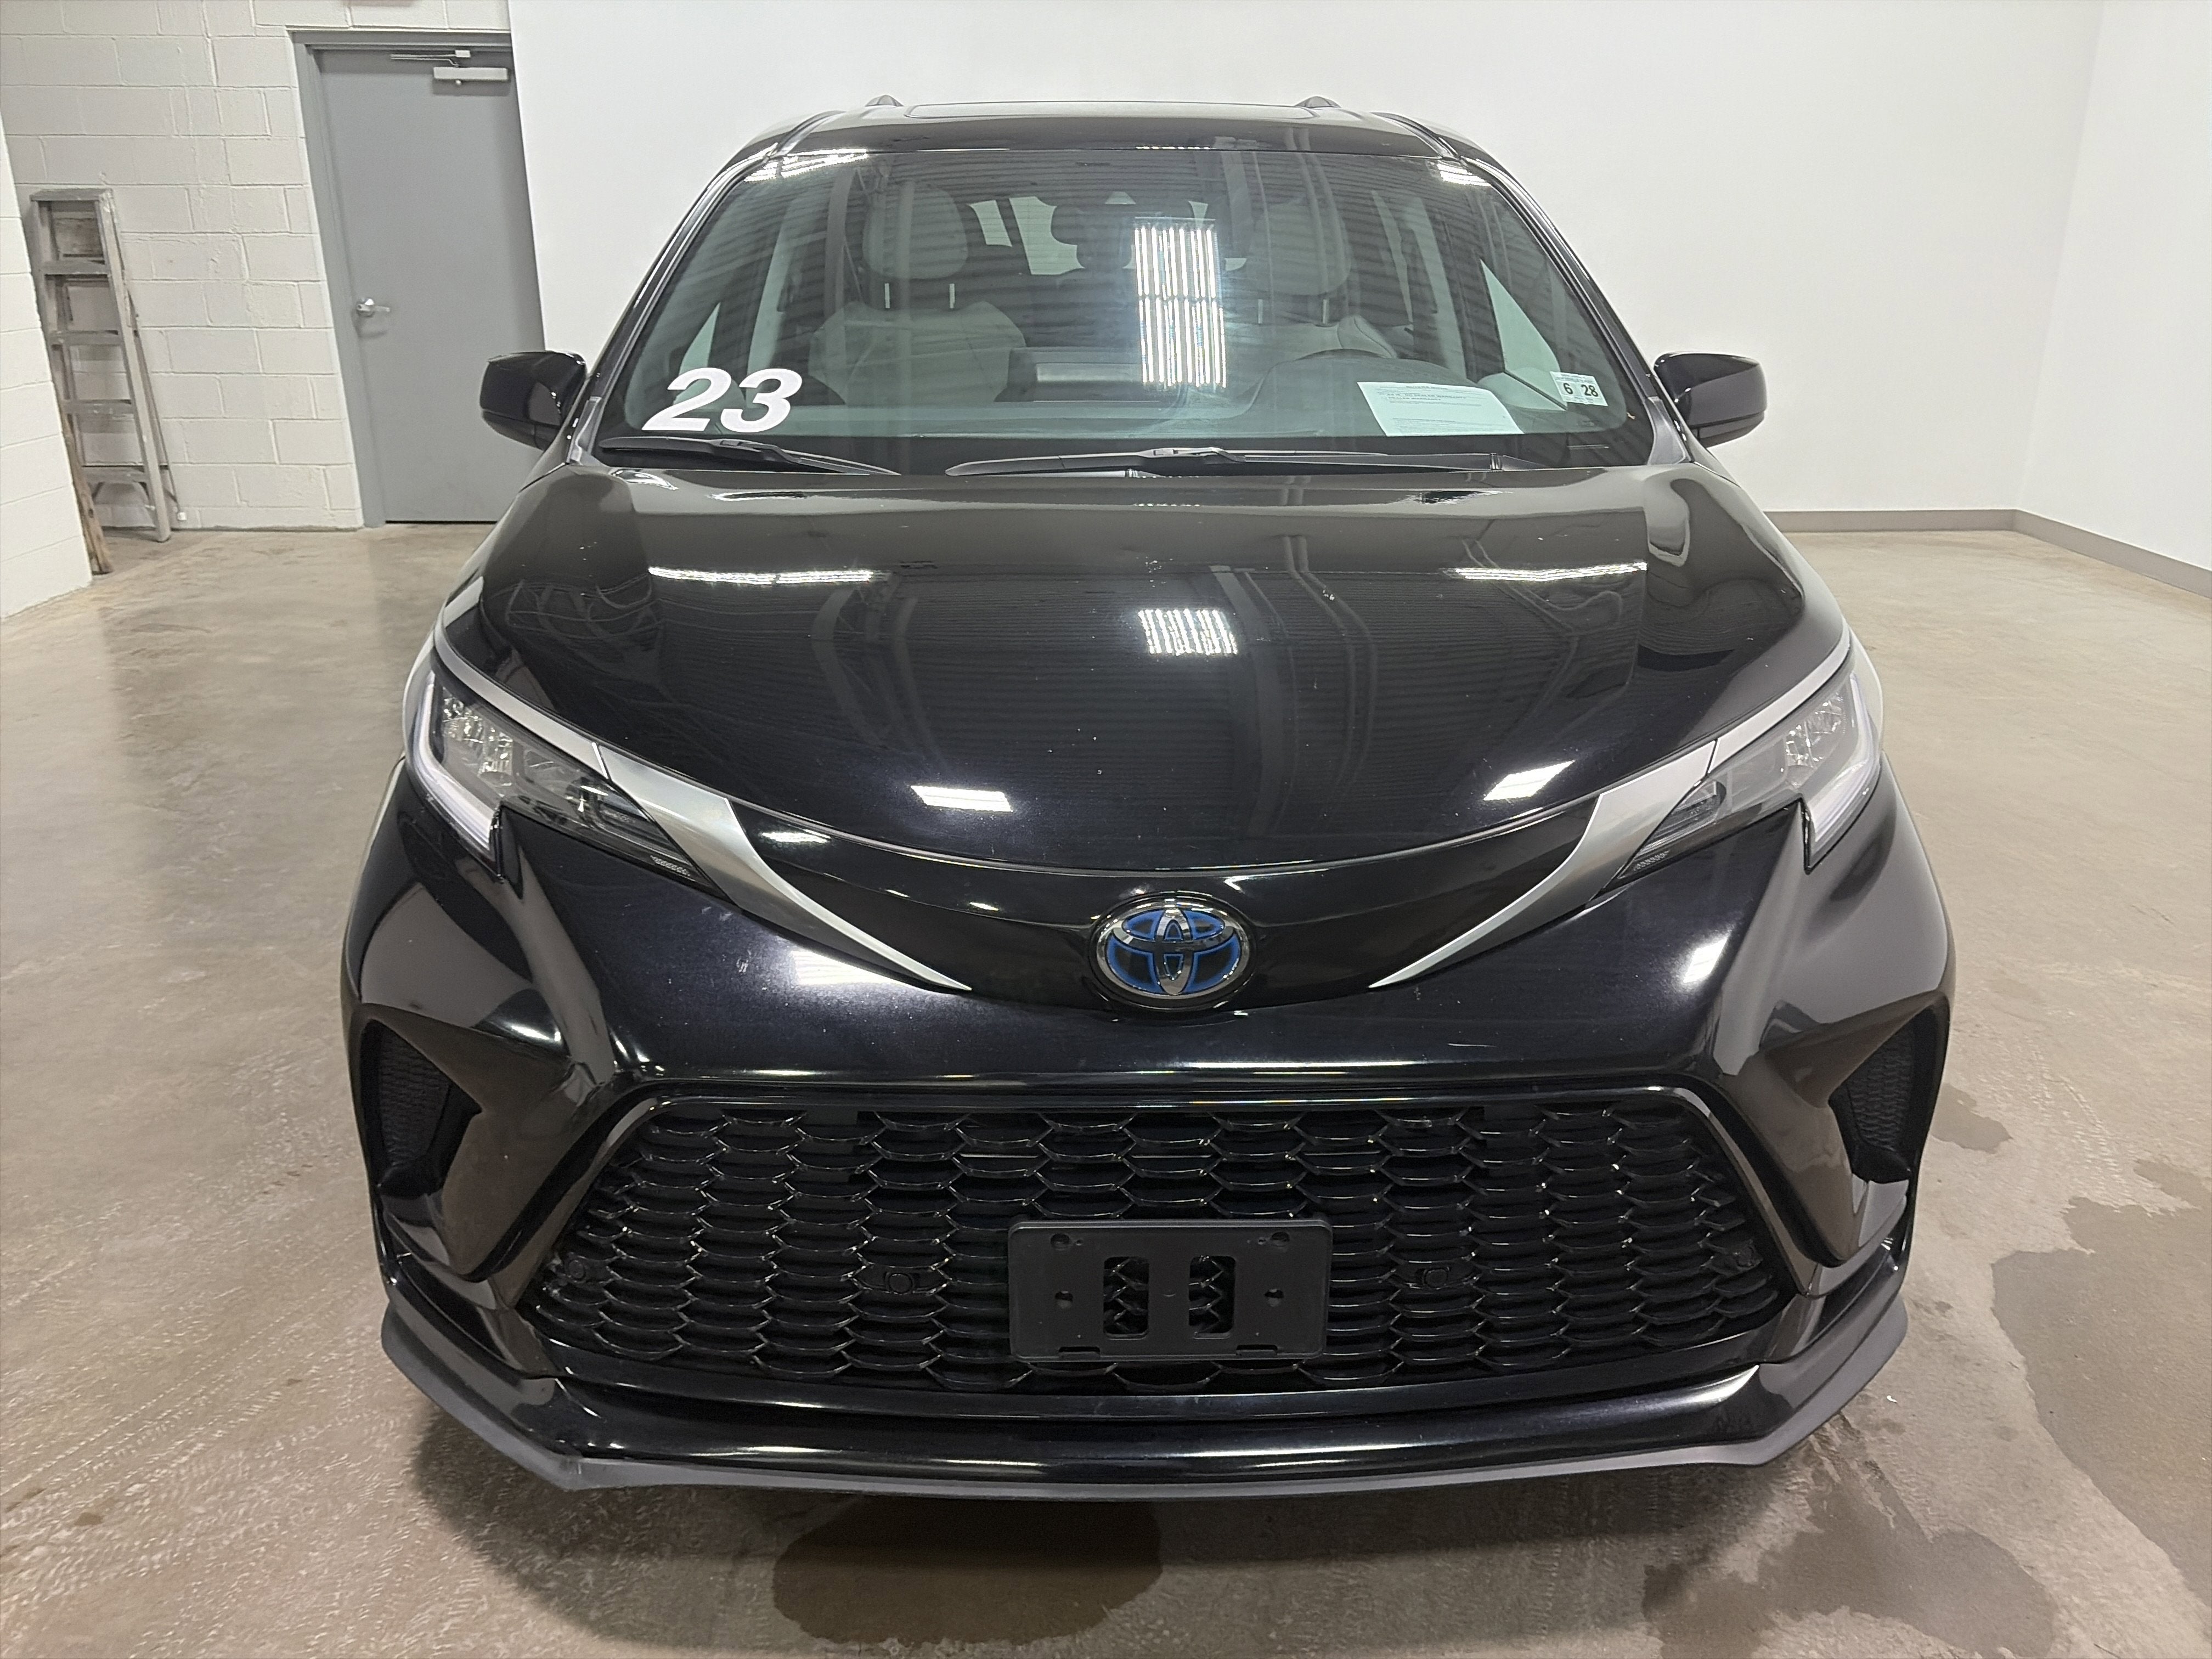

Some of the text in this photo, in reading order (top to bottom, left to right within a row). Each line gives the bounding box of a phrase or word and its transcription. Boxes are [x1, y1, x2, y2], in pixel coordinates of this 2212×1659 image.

[641, 367, 803, 433] 23
[1563, 383, 1599, 397] 6 28
